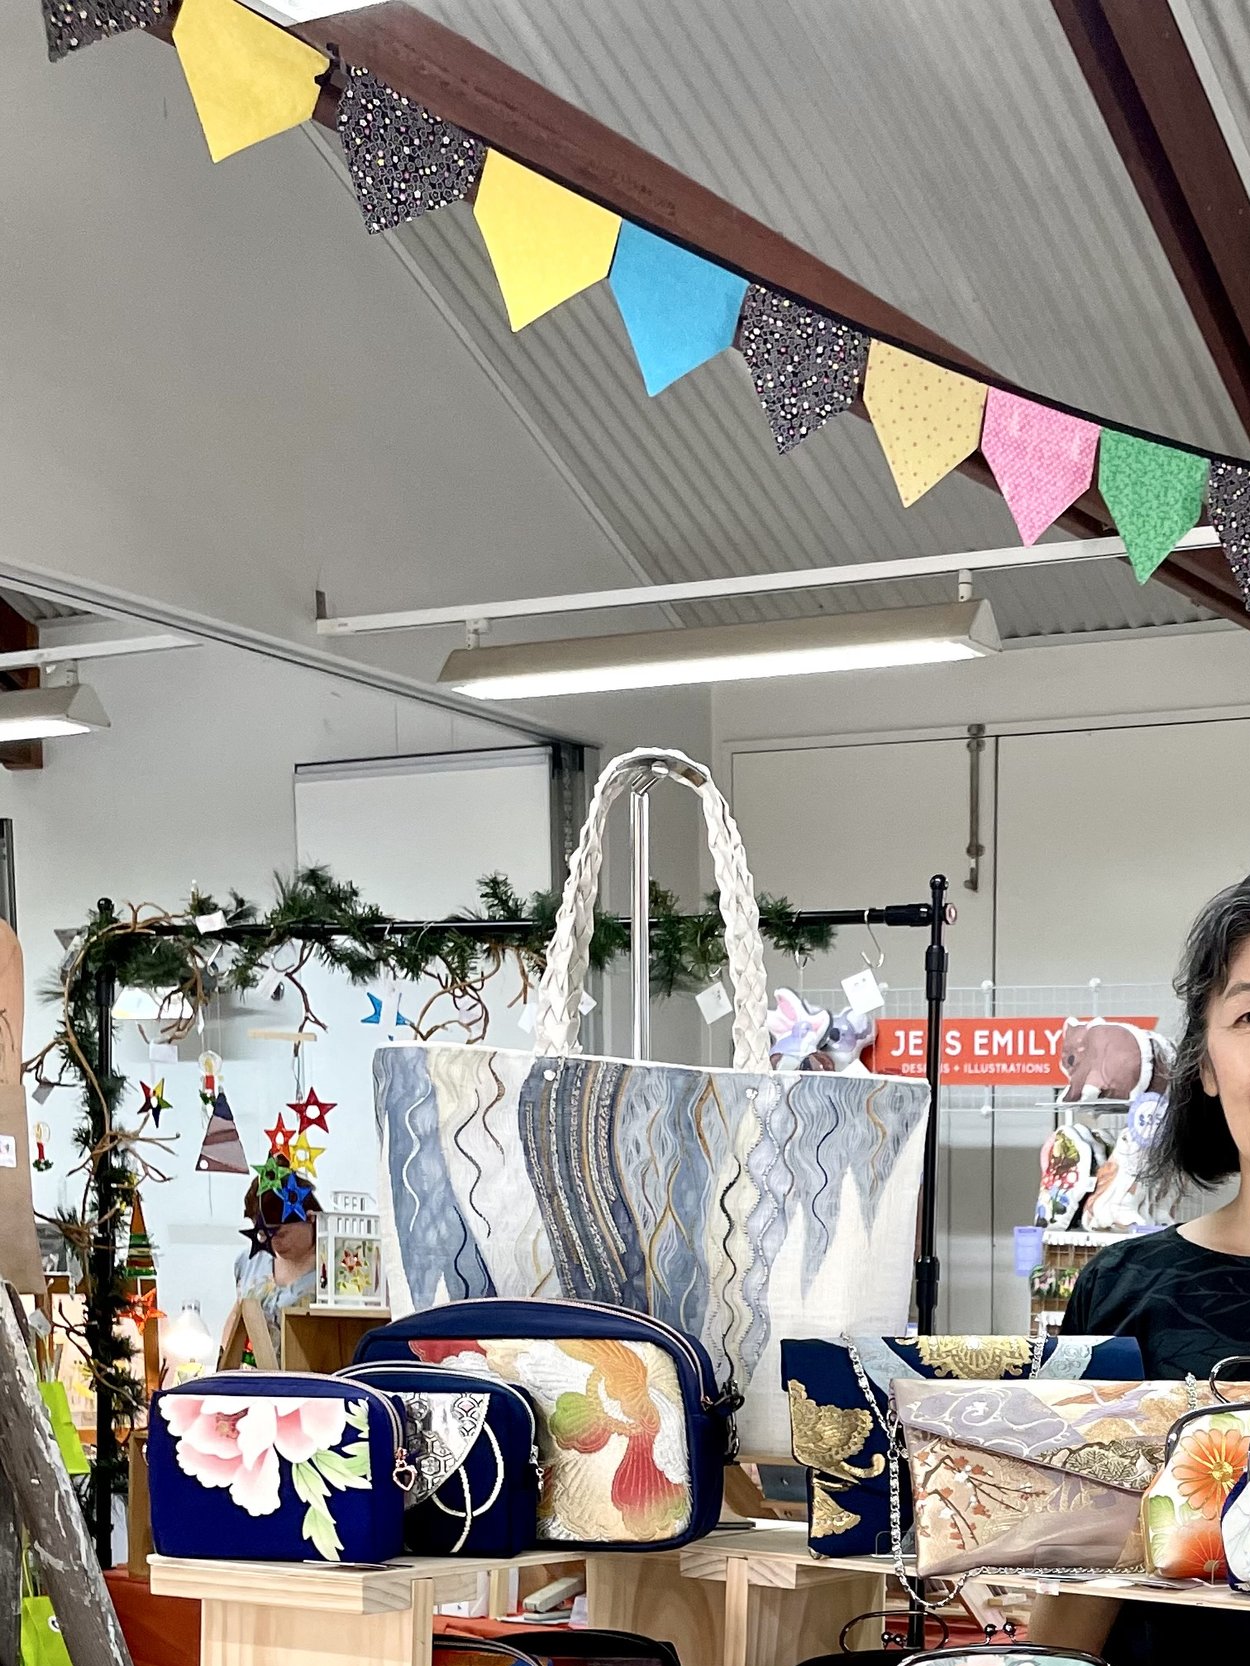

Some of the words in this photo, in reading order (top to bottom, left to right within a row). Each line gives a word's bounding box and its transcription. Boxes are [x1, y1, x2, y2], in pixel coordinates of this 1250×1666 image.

[891, 1030, 962, 1057] JES
[974, 1029, 1063, 1056] EMILY
[963, 1063, 1051, 1074] ILLUSTRATIONS
